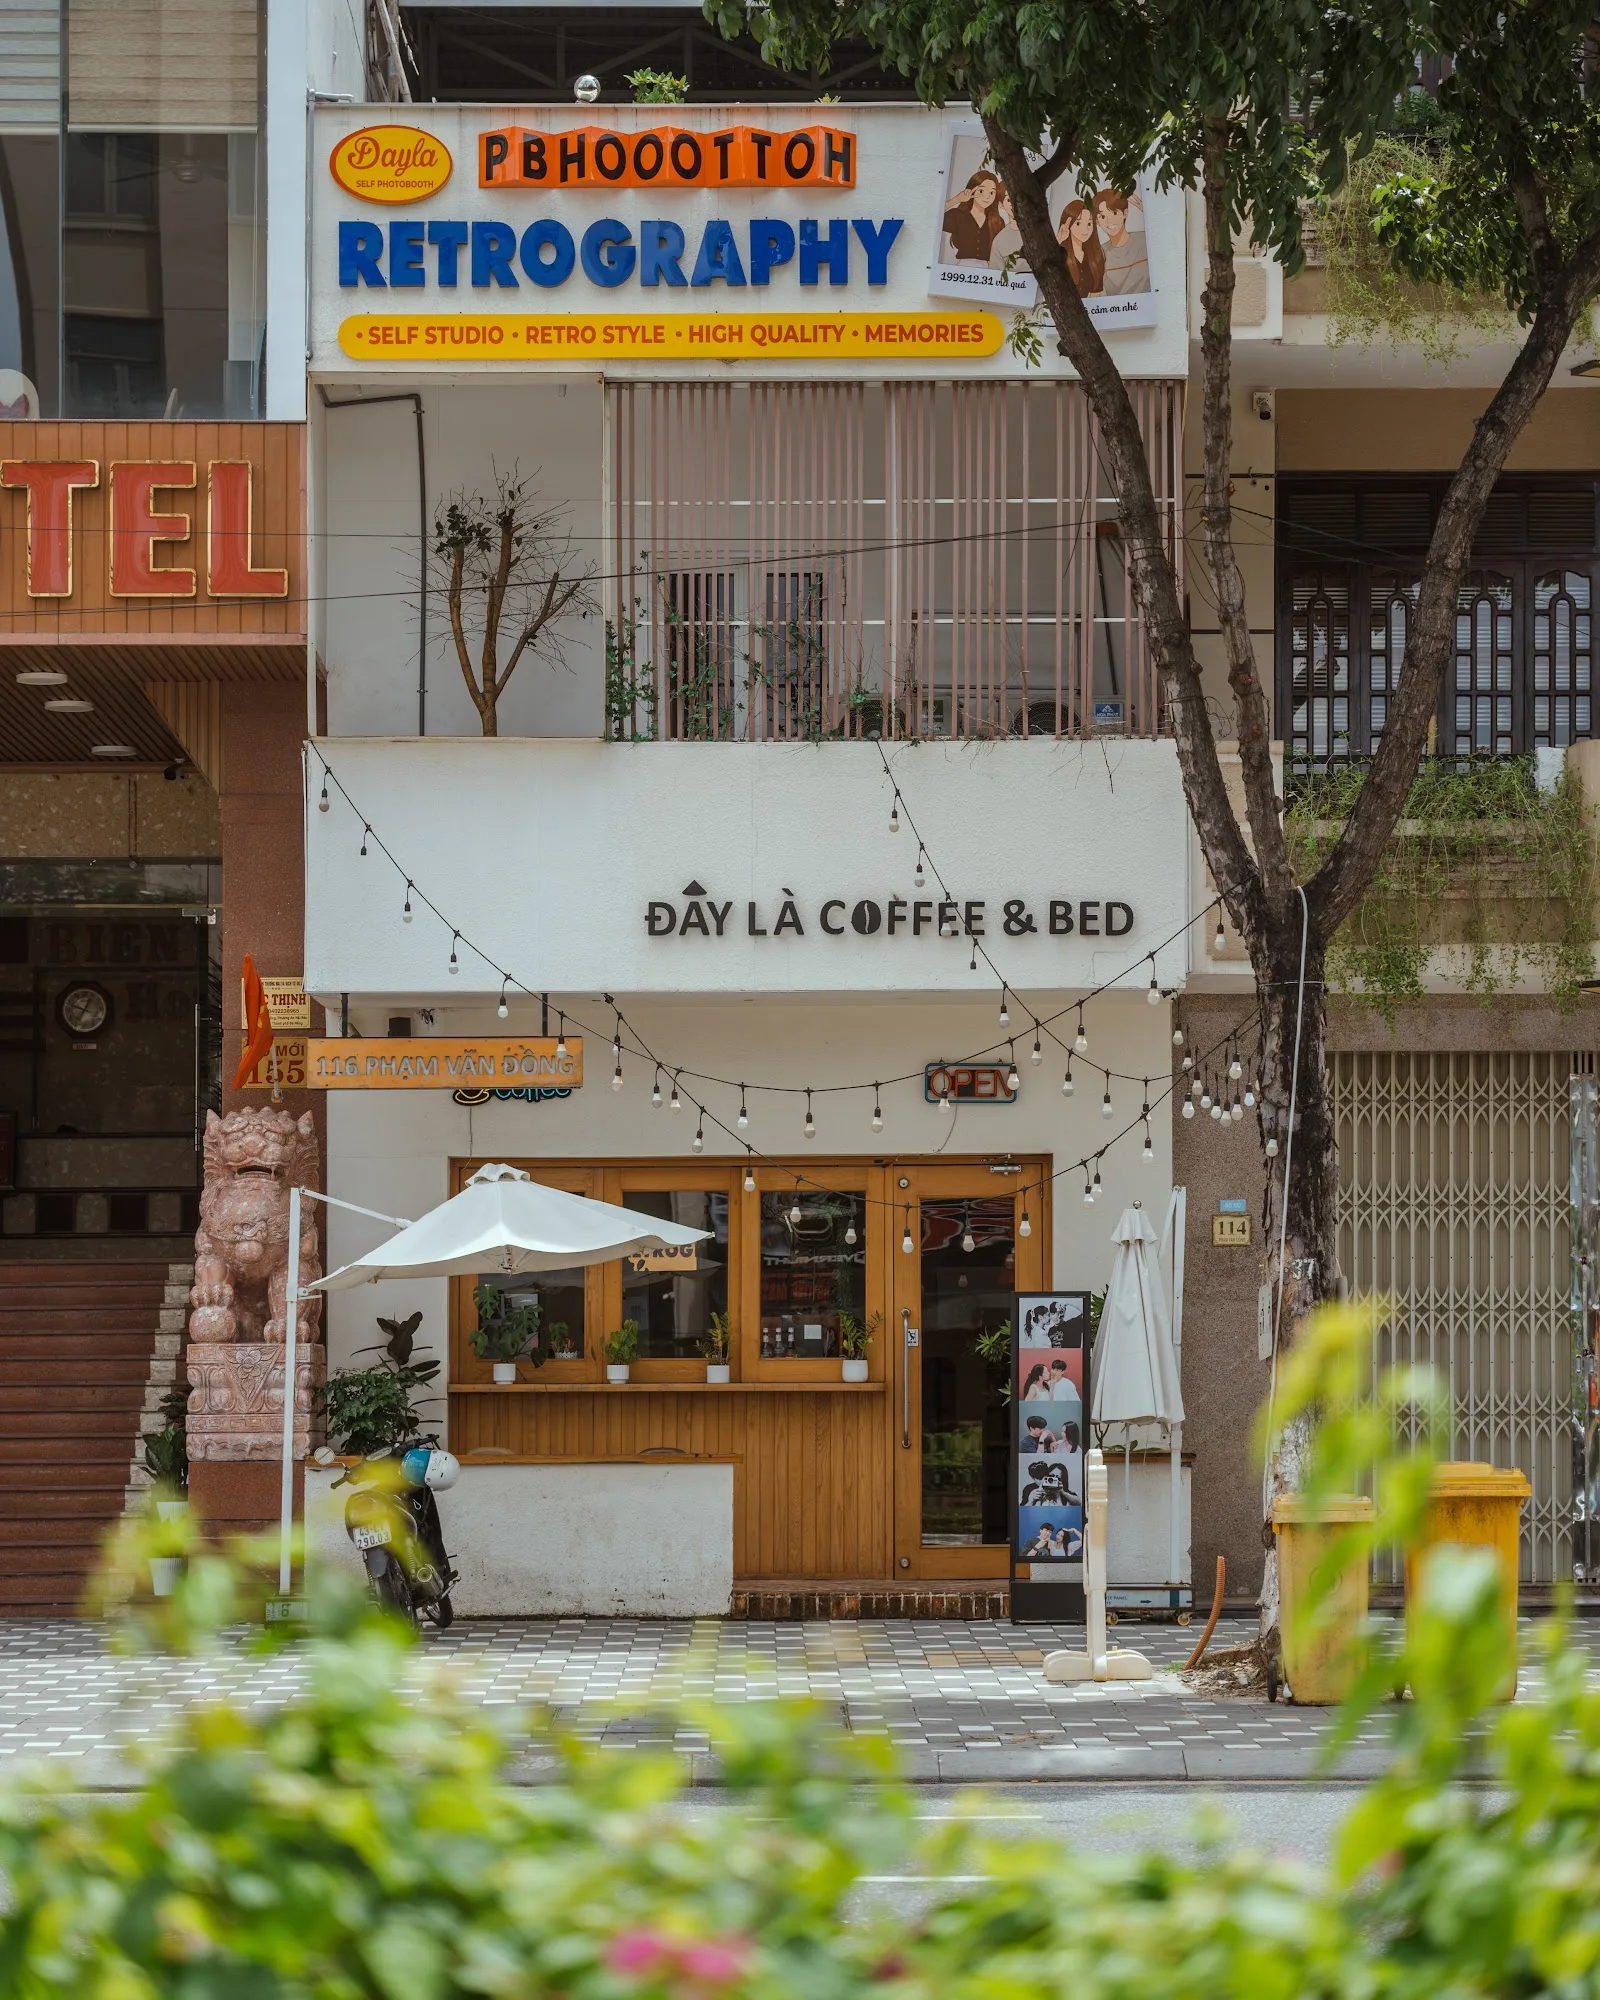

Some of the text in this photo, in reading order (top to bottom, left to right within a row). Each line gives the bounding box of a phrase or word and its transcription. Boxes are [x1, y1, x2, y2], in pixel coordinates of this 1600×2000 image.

[347, 135, 438, 177] Dayla
[355, 180, 434, 188] SELF PHOTOBOOTH
[338, 218, 904, 288] RETROGRAPHY
[940, 271, 994, 286] 1999.12.31
[1122, 301, 1139, 312] nhé
[368, 323, 984, 347] SELF STUDIO RETRO STYLE HIGH QUALITY MEMORIES
[645, 880, 1135, 937] ĐÂY LÀ COFFEE & BED
[272, 994, 306, 1008] THỊNH
[276, 1042, 304, 1056] MỚI
[247, 1059, 305, 1084] 155
[316, 1046, 575, 1080] 116 PHẠM VĂN ĐỒNG
[930, 1069, 1014, 1097] OPEN
[1217, 1220, 1247, 1235] 114
[1292, 1258, 1316, 1280] 37
[357, 1532, 388, 1549] 290.03
